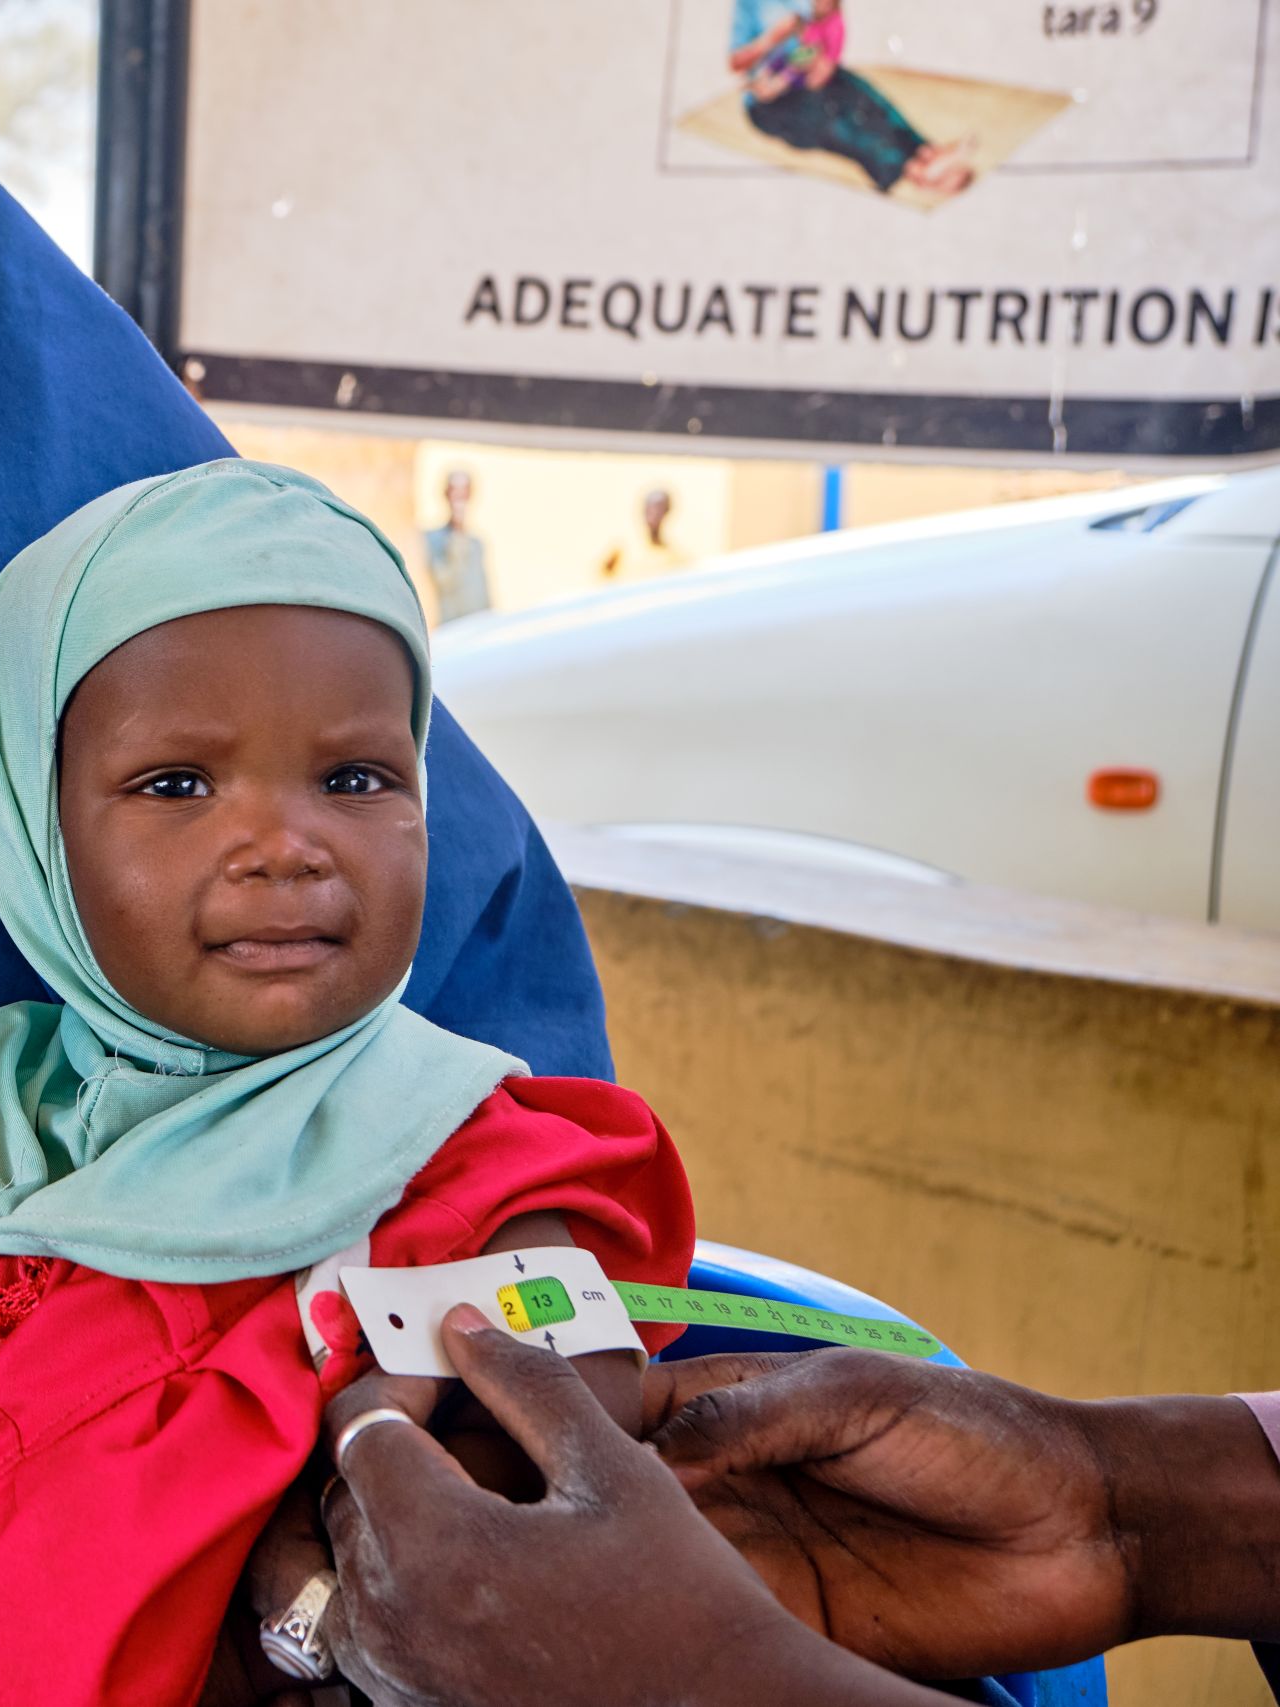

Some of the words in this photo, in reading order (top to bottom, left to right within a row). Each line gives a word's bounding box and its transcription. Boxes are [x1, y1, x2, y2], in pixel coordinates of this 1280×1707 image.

[1042, 5, 1121, 39] tara
[464, 275, 821, 340] ADEQUATE
[840, 286, 1236, 346] NUTRITION
[1254, 287, 1280, 345] I
[531, 1294, 553, 1309] 13
[582, 1290, 606, 1301] cm
[629, 1294, 647, 1307] 16
[657, 1297, 673, 1309] 17
[685, 1300, 704, 1313] 18
[713, 1302, 731, 1315] 19
[740, 1305, 758, 1318] 20
[767, 1309, 785, 1321] 21
[792, 1312, 810, 1326] 22
[816, 1318, 834, 1331] 23
[840, 1323, 857, 1336] 24
[864, 1327, 882, 1340] 25
[889, 1330, 907, 1343] 26
